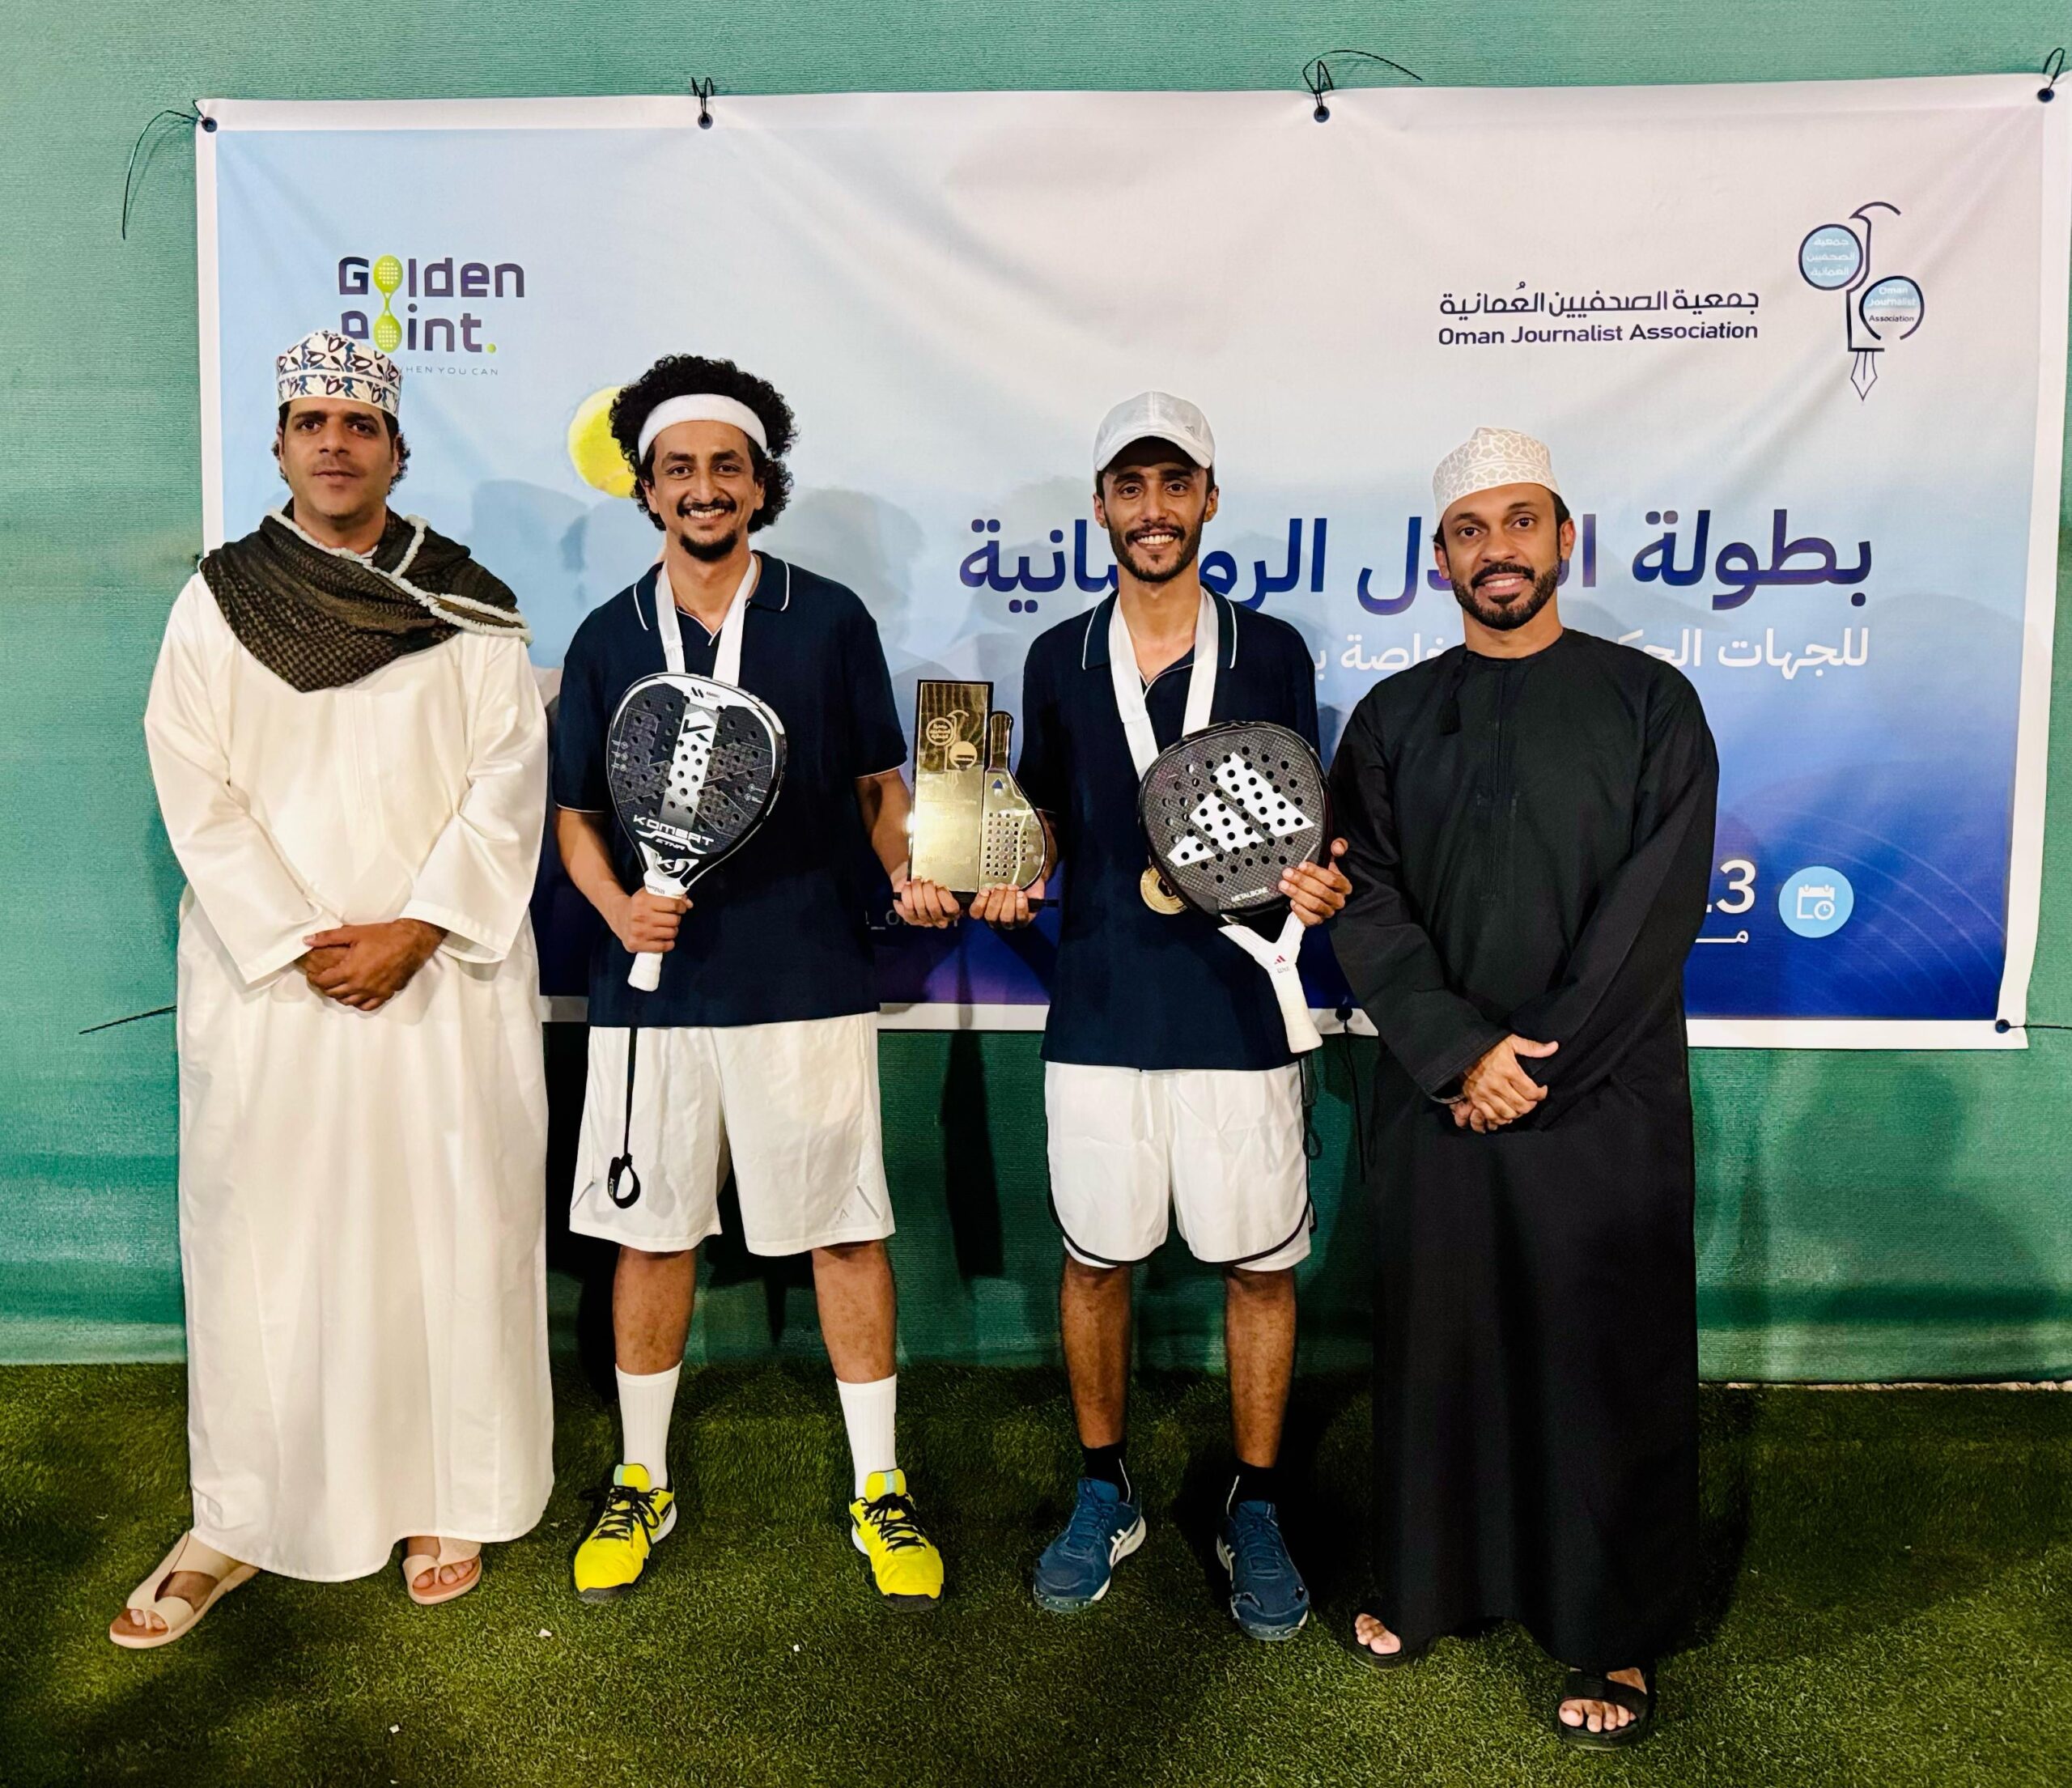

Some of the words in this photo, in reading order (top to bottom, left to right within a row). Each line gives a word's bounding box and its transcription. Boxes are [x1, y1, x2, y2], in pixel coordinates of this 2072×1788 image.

[1548, 290, 1667, 318] الصحفيين
[1672, 289, 1759, 315] جمعية
[1869, 298, 1917, 307] Journalist
[1879, 287, 1909, 295] Oman
[1438, 328, 1505, 345] Oman
[1511, 325, 1623, 343] Journalist
[1629, 321, 1758, 341] Association
[401, 366, 433, 374] HEN
[471, 367, 499, 376] CAN
[959, 517, 1327, 614] الرمانية
[1632, 508, 1872, 610] بطولة
[1717, 627, 1869, 680] للجهات
[633, 814, 715, 846] KOMBAT
